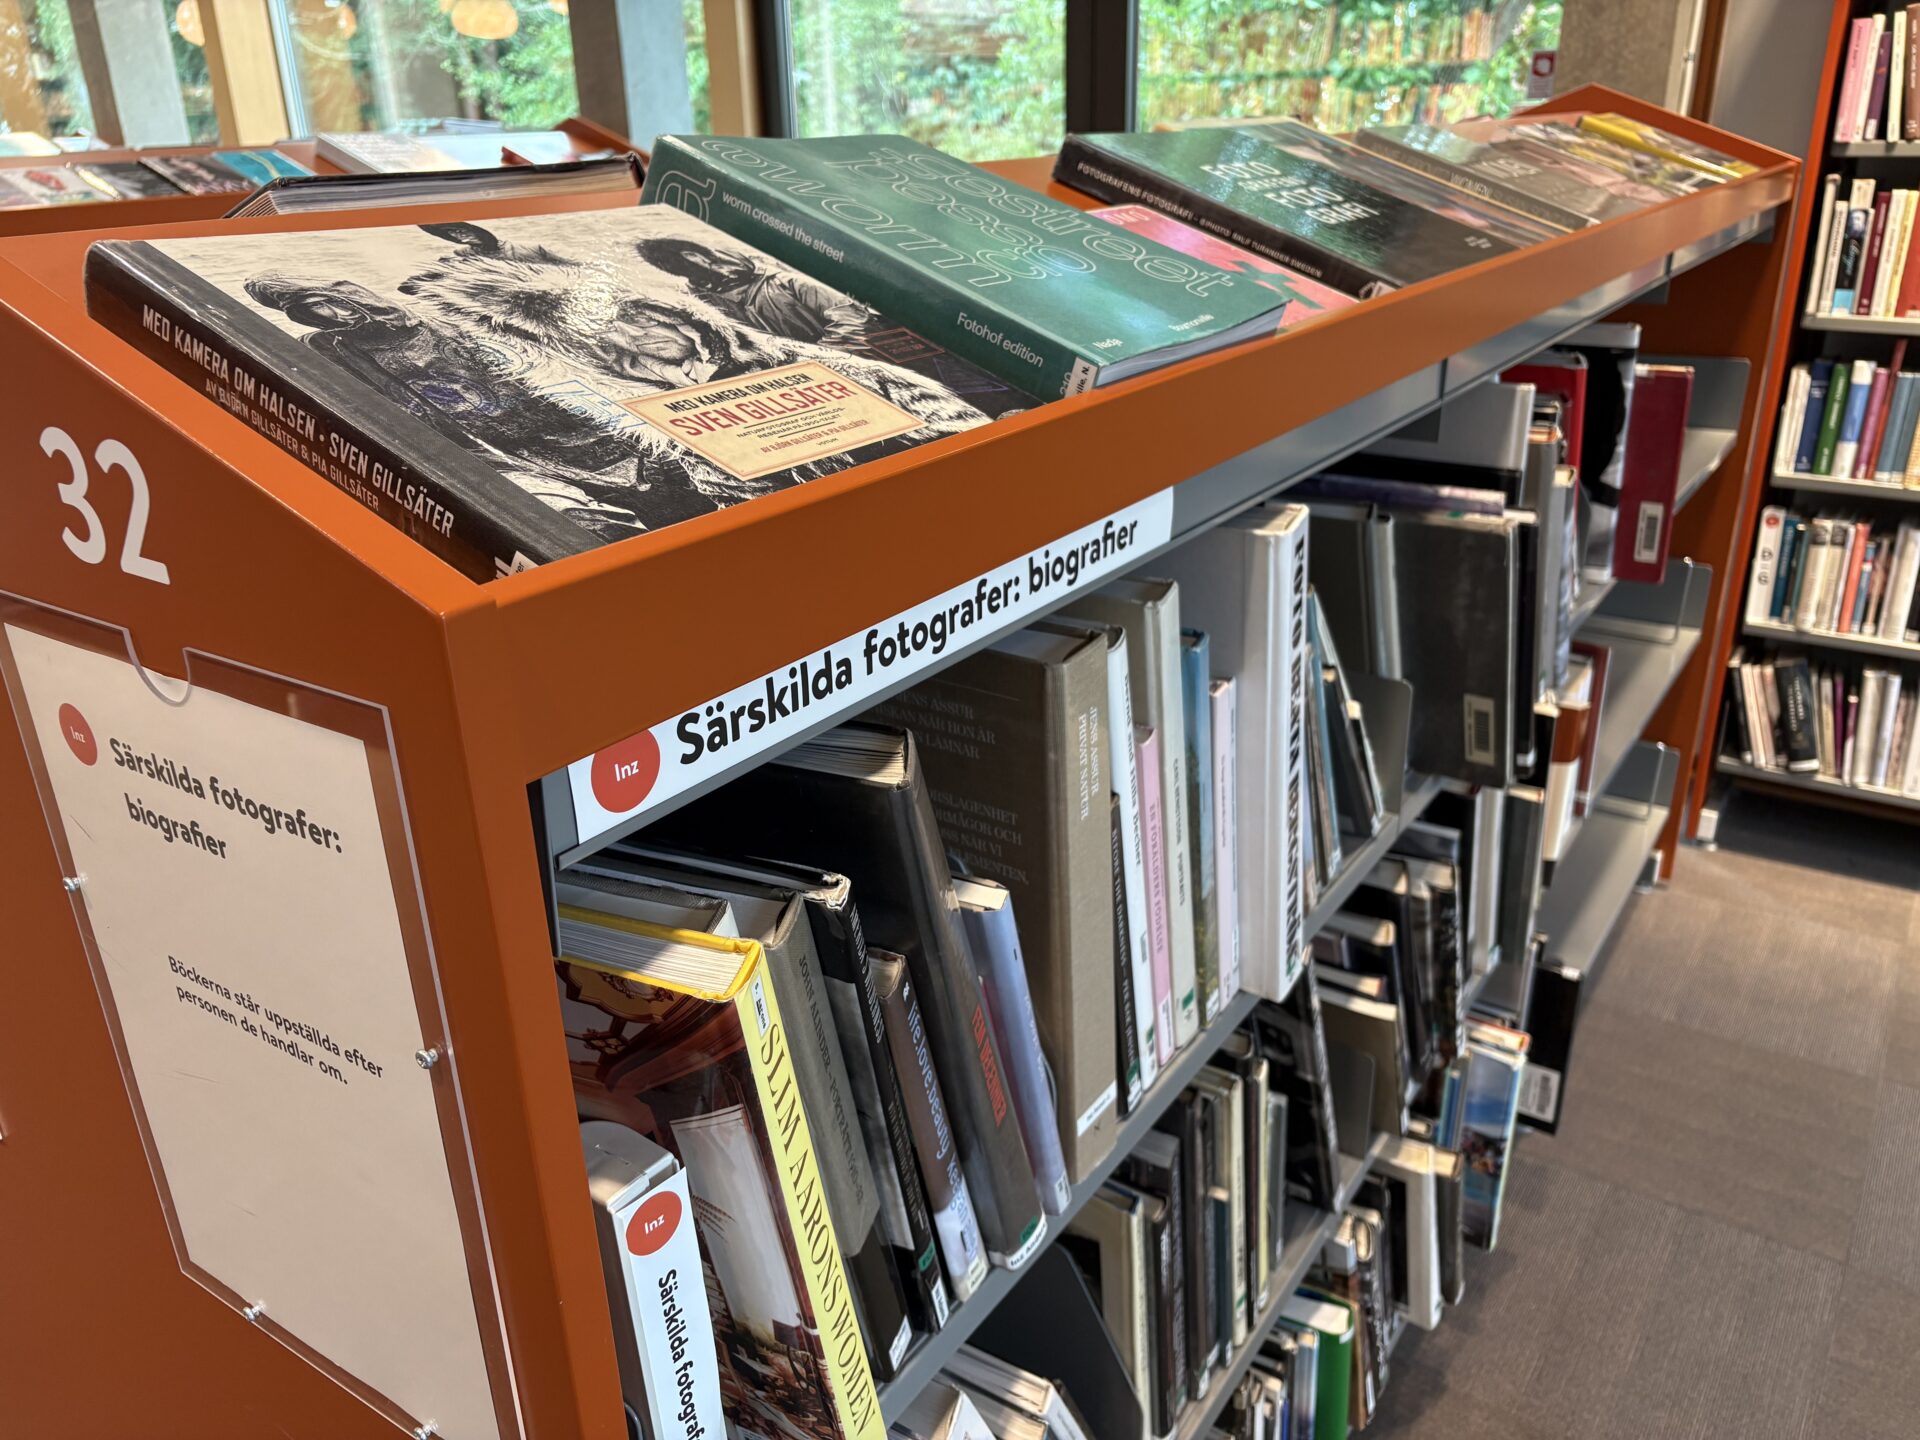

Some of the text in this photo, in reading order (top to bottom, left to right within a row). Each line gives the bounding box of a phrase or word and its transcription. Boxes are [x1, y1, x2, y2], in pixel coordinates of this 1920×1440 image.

[722, 192, 751, 215] worm
[752, 206, 794, 236] crossed
[795, 223, 813, 246] the
[812, 237, 845, 263] street
[956, 312, 1003, 347] Fotohof
[1002, 335, 1045, 368] edition
[142, 304, 455, 539] MED KAMERA OM HALSEN SVEN GILLSÄTER
[663, 373, 814, 413] MED KAMERA OM HALSEN
[668, 405, 747, 437] SVEN
[737, 379, 858, 421] GILLSÄTER
[205, 379, 380, 511] AV BJÖRN GILLSÄTER & PIA GILLSÄTER
[39, 427, 171, 586] 32
[676, 516, 1139, 765] Särskilda fotografer: biografier
[69, 725, 86, 744] Inz
[614, 758, 639, 783] Inz
[109, 738, 343, 854] Särskilda fotografer:
[124, 793, 227, 859] biografier
[168, 955, 384, 1079] Böckerna står uppställda efter
[176, 984, 349, 1085] personen de handlar om.
[799, 952, 815, 999] JOHN
[810, 1002, 831, 1074] ALINDER
[907, 1000, 950, 1160] life.love.beauty
[644, 1214, 665, 1235] Inz
[761, 1023, 877, 1438] SLIM AARONS WOMEN
[658, 1268, 689, 1364] Särskilda
